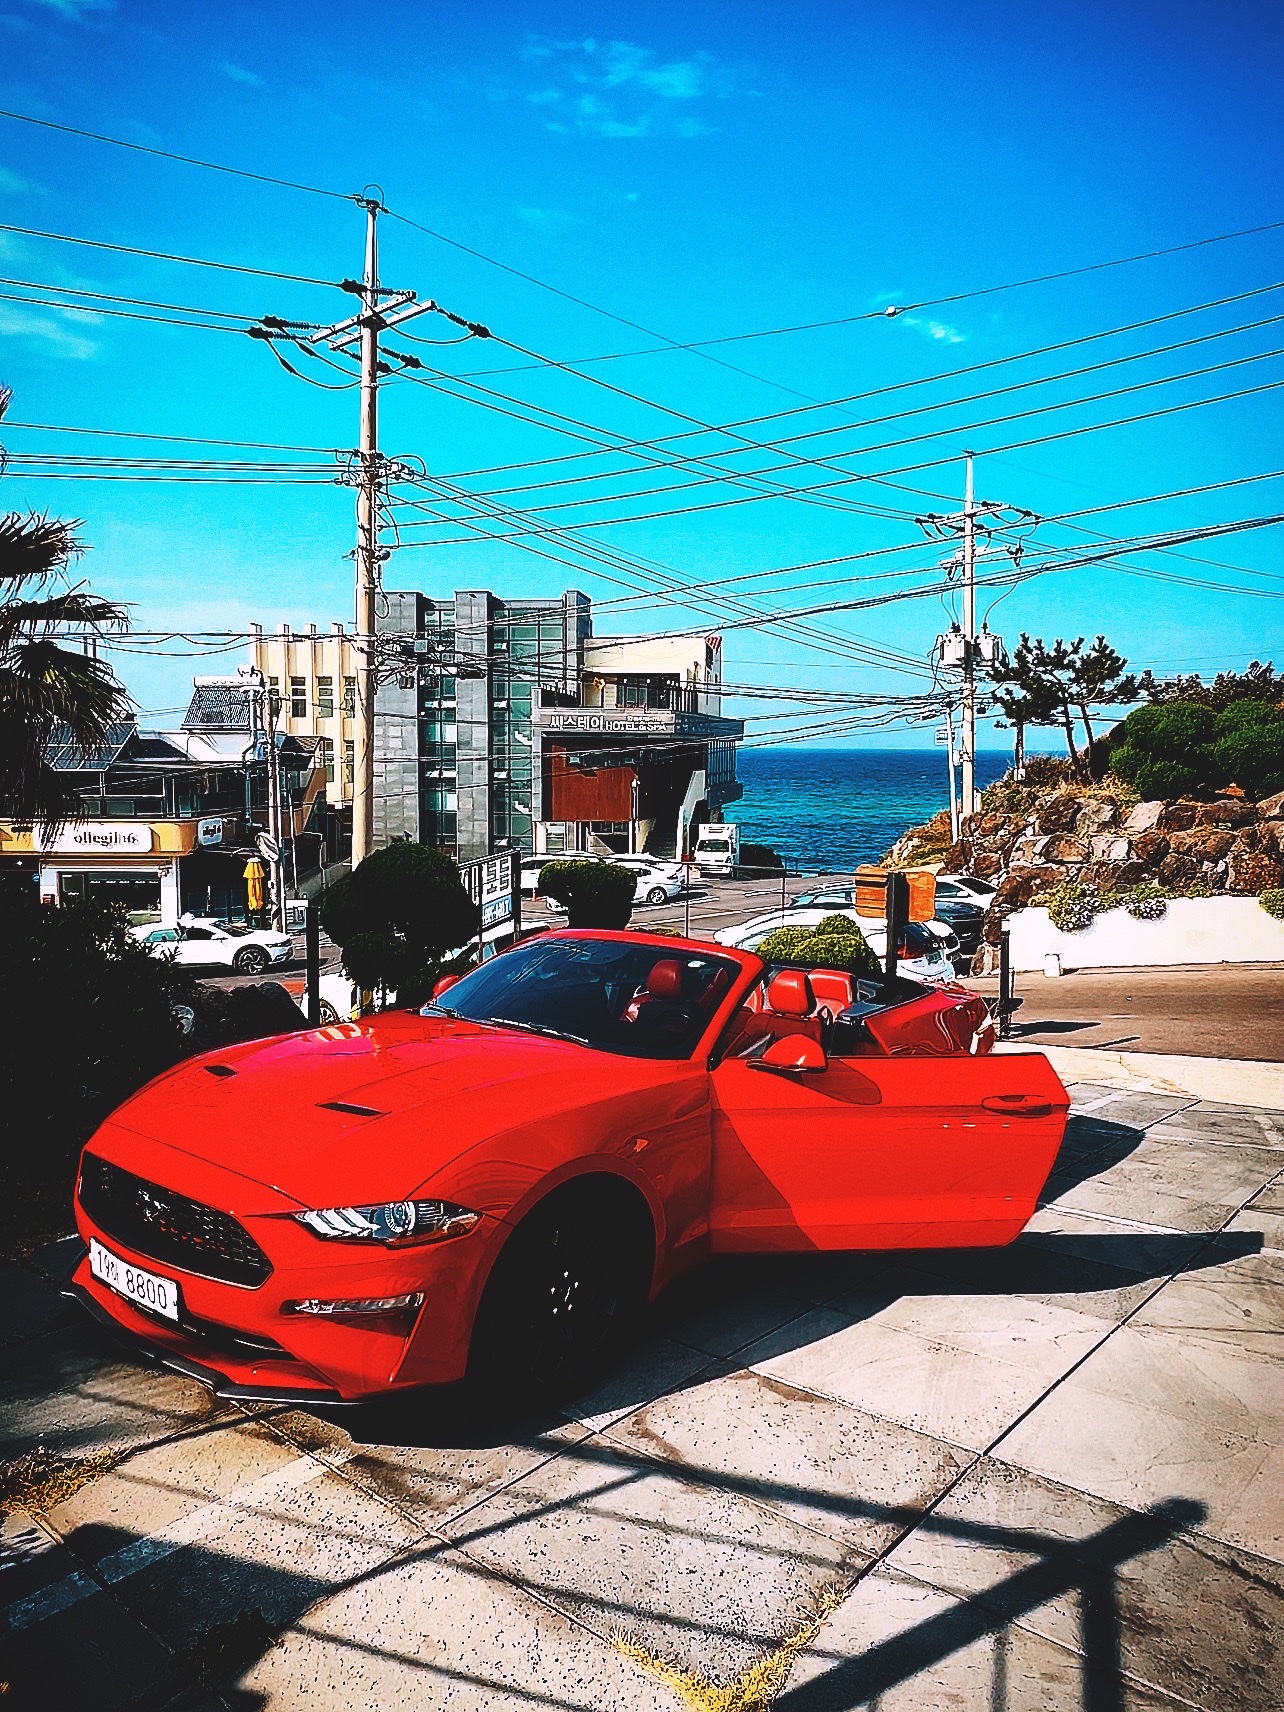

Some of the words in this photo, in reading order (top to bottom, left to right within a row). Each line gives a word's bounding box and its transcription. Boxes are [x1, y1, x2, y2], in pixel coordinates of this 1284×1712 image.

[550, 715, 604, 731] 씨스테이
[606, 720, 639, 731] HOTEL
[126, 1269, 167, 1309] 8800
